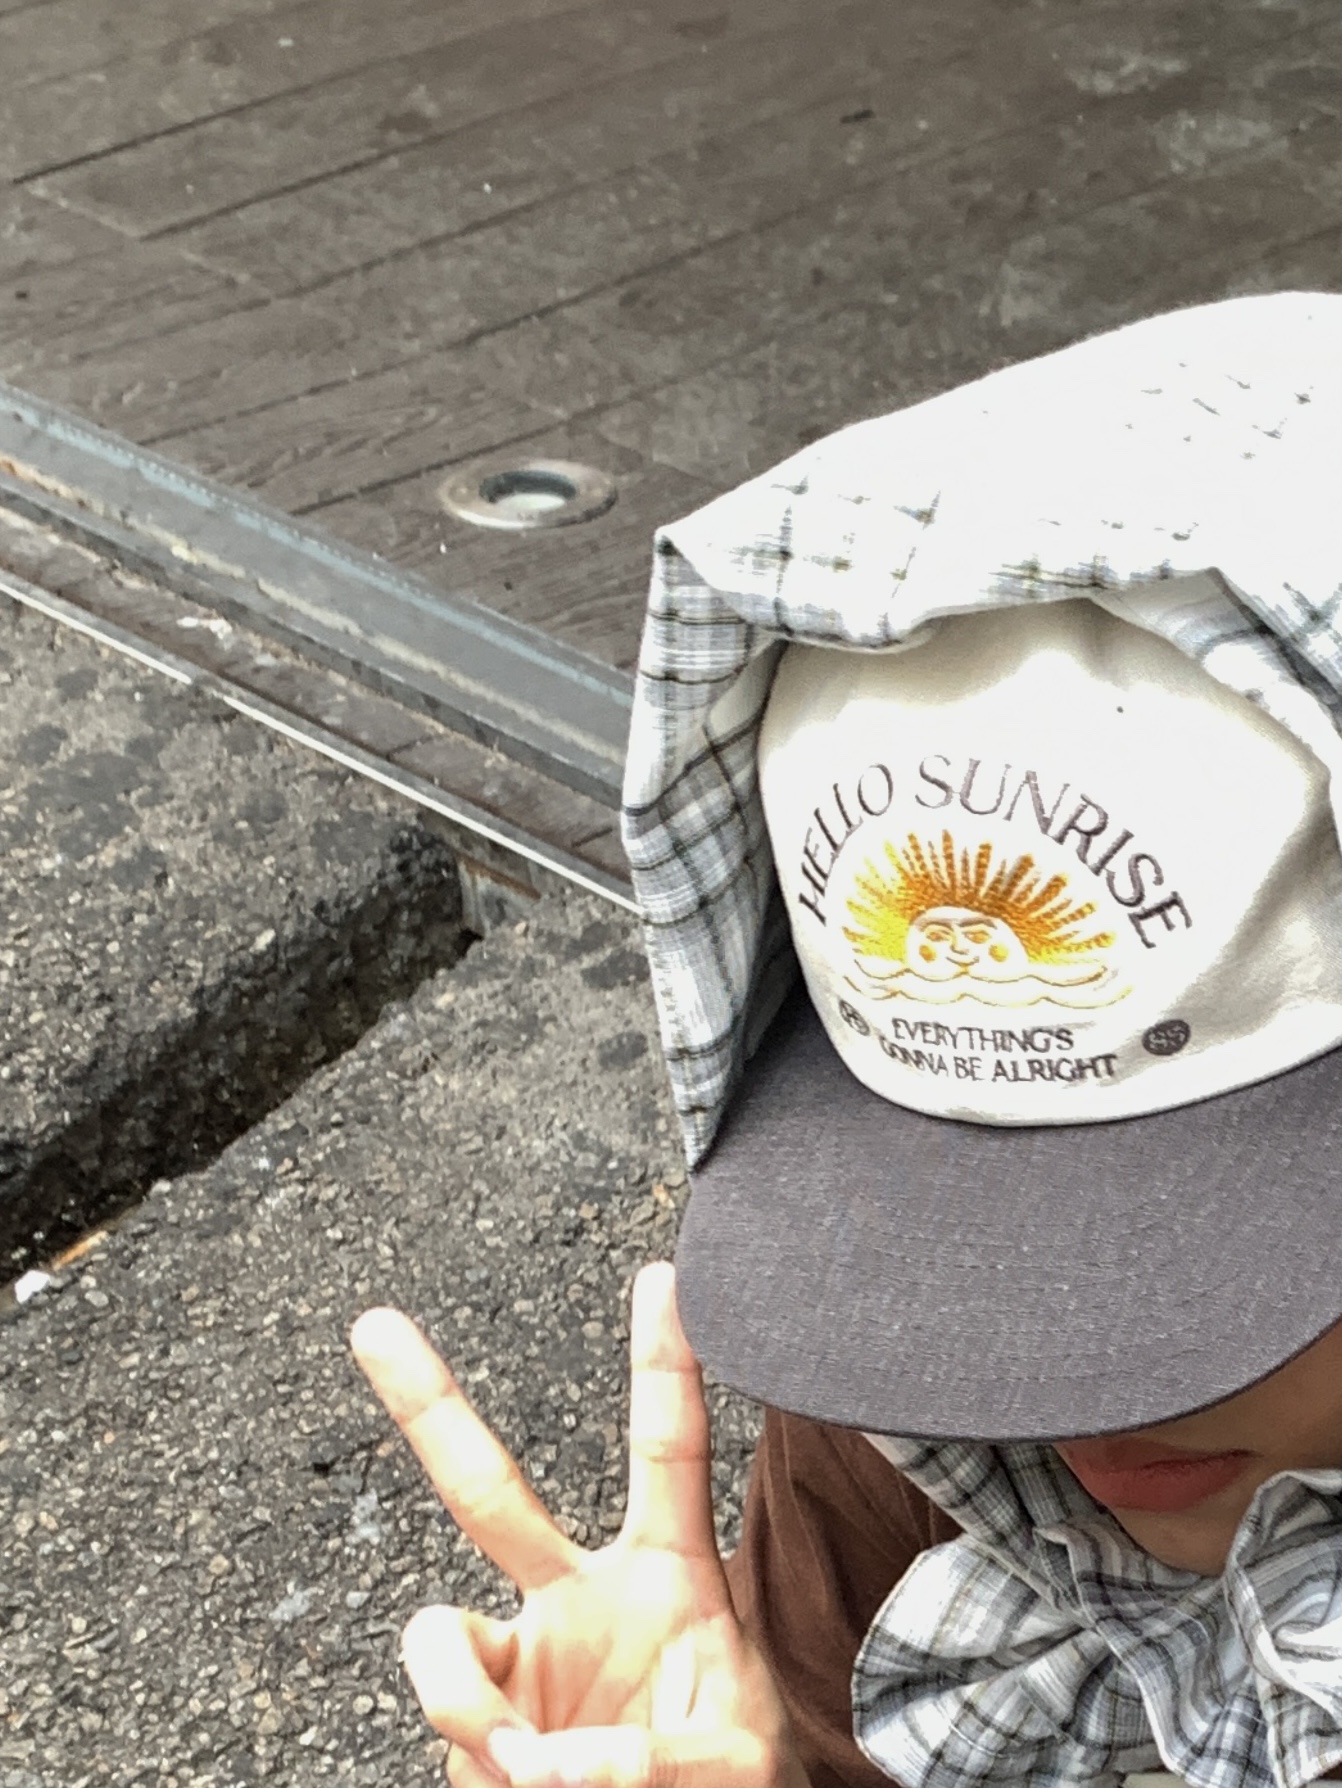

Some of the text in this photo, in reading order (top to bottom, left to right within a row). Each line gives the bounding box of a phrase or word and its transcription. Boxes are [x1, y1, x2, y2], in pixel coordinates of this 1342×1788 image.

[798, 754, 1193, 949] HELLO SUNRISE
[953, 1056, 985, 1082] BE
[991, 1053, 1118, 1083] ALRIGHT
